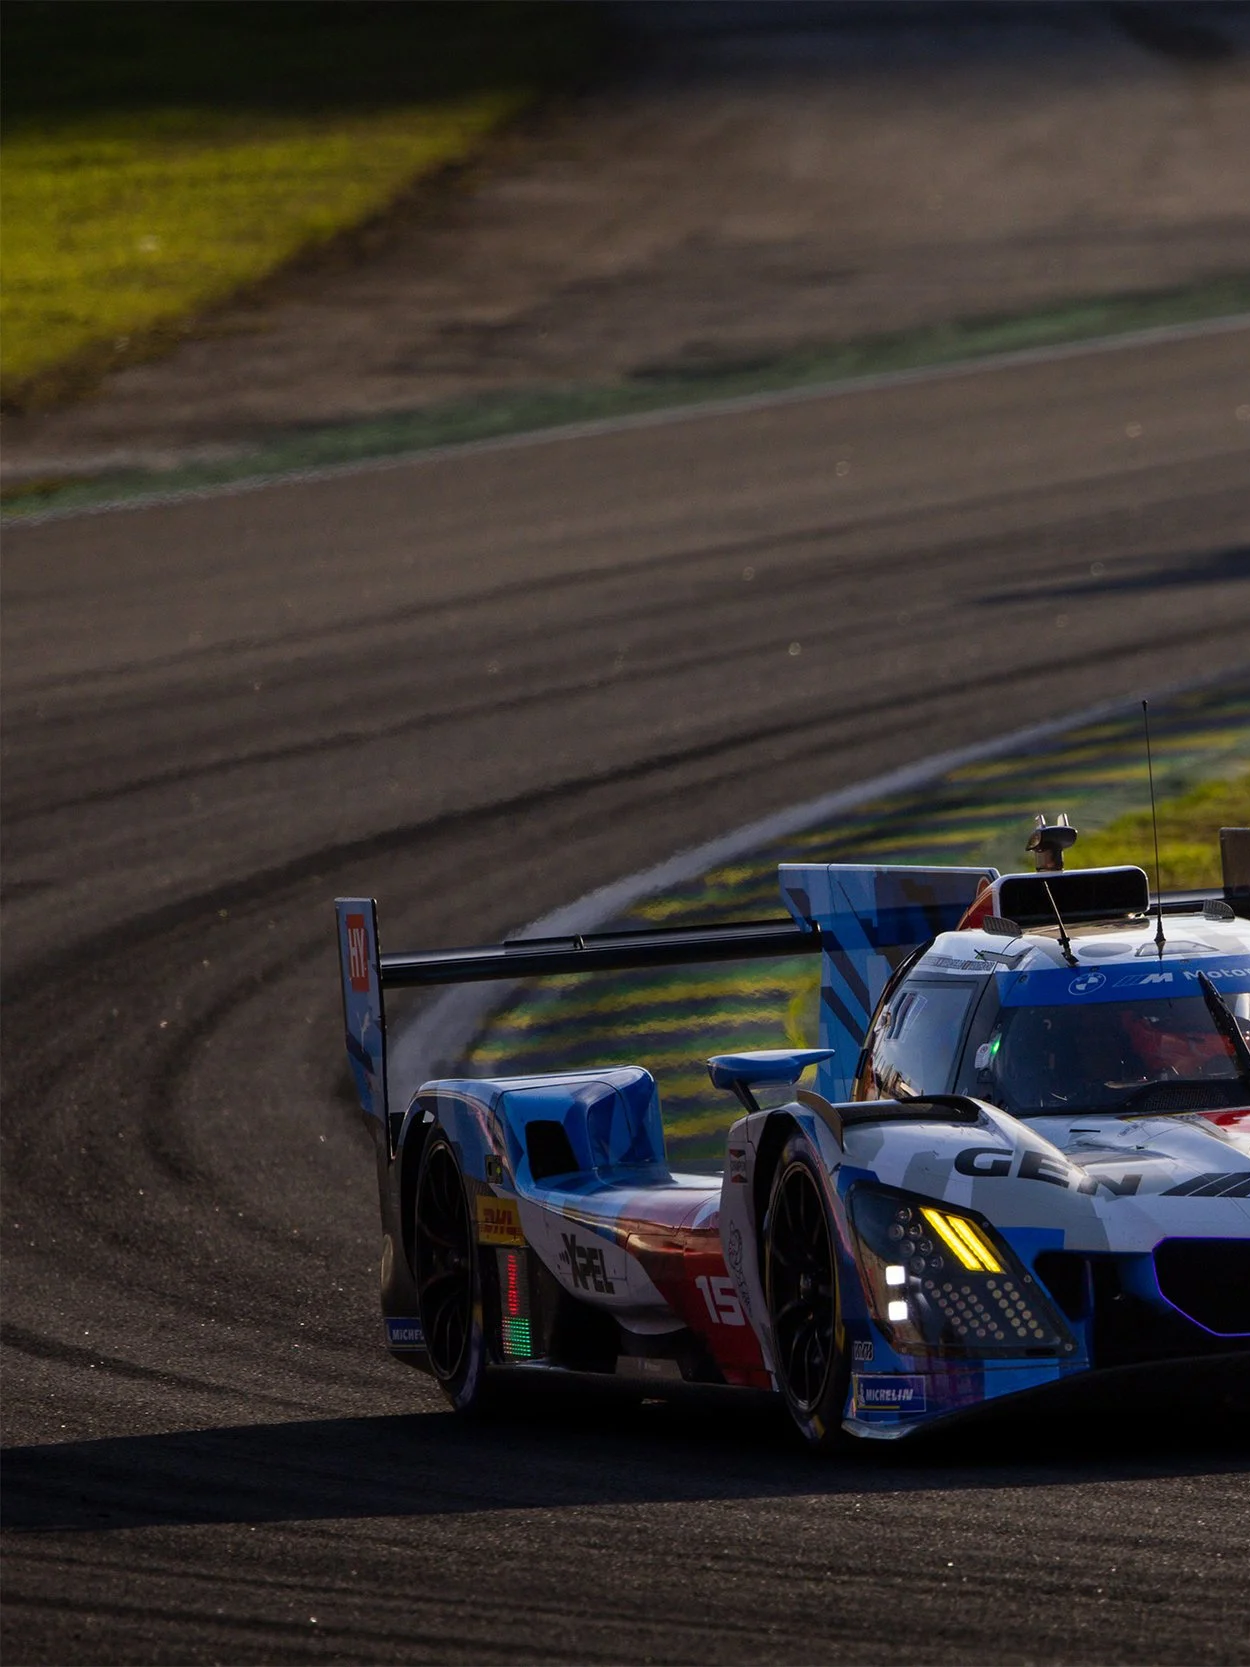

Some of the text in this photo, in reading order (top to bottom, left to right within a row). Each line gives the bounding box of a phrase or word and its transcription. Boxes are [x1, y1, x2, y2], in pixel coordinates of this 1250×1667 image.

[347, 927, 366, 978] HY
[954, 1146, 1143, 1197] GEN
[561, 1232, 616, 1295] XPEL
[694, 1274, 746, 1327] 15
[865, 1388, 914, 1401] MICHELIN
